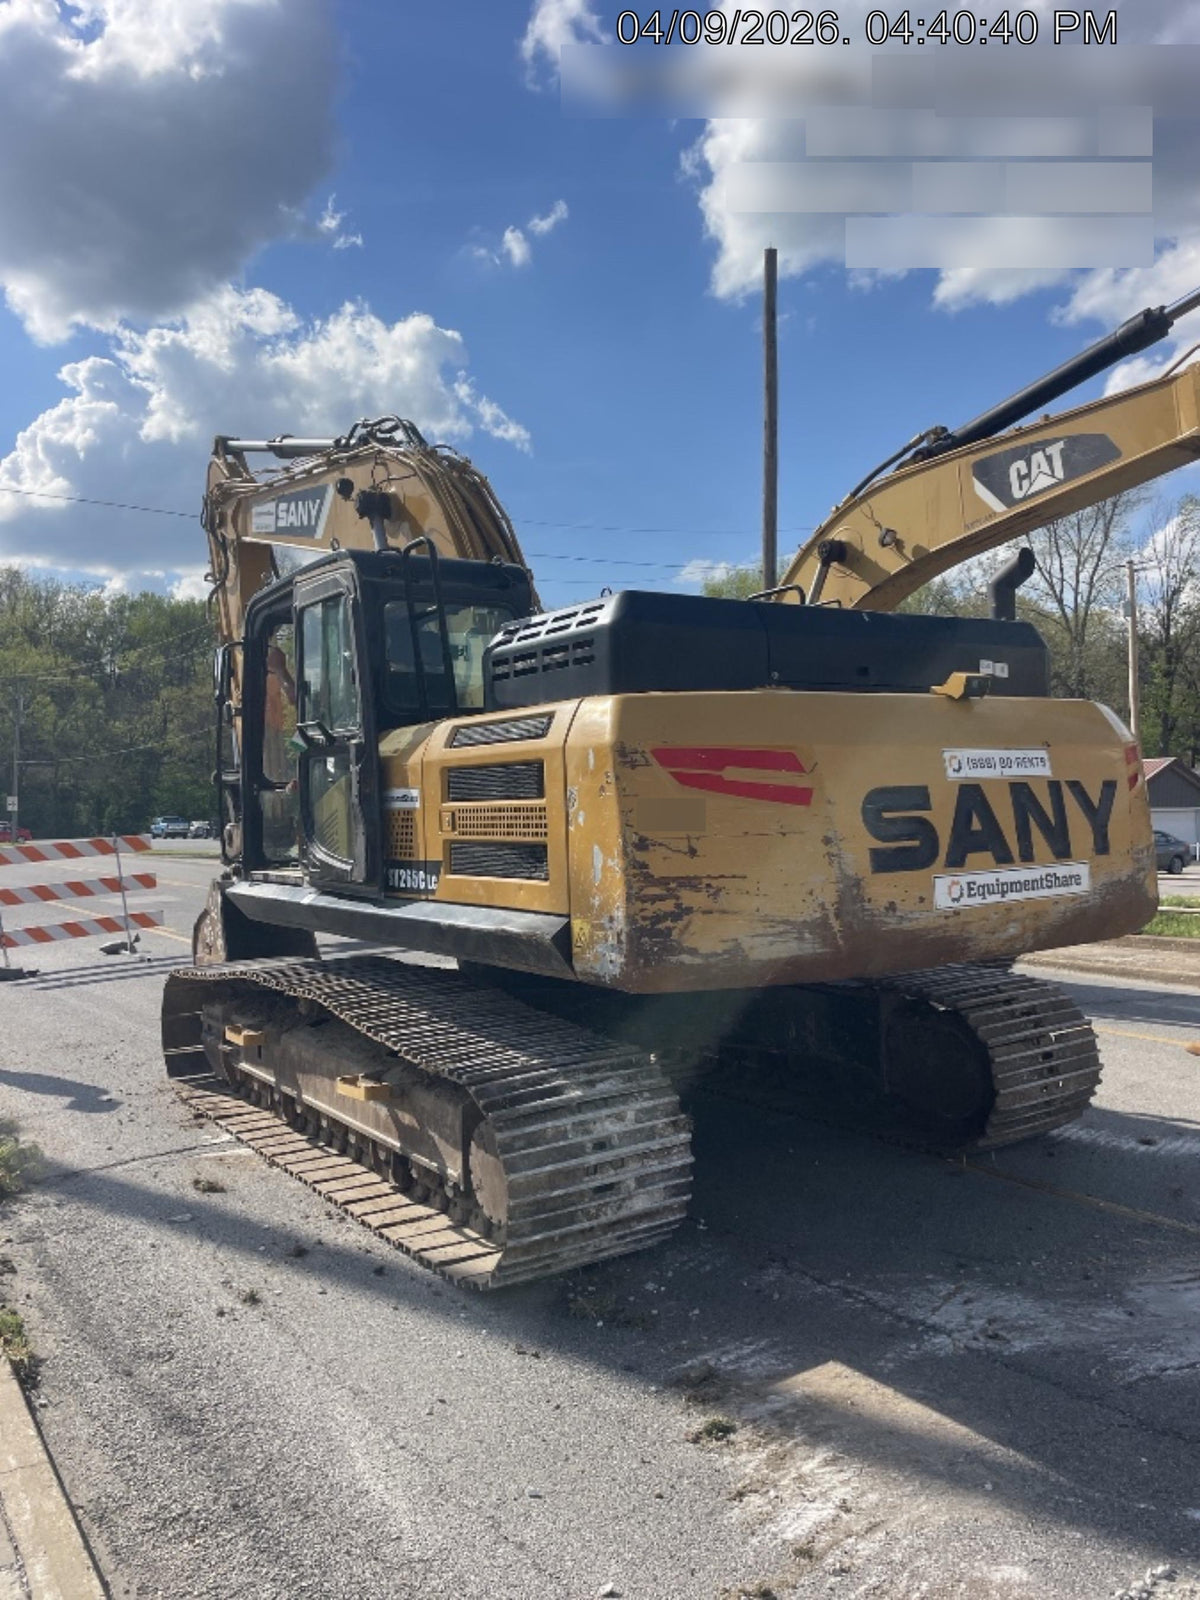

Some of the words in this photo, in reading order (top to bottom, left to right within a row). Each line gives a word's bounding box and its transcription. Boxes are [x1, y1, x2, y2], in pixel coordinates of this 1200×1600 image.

[1009, 439, 1067, 499] CAT
[277, 499, 321, 527] SANY
[861, 780, 1117, 874] SANY
[966, 873, 1082, 900] EquipmentShare
